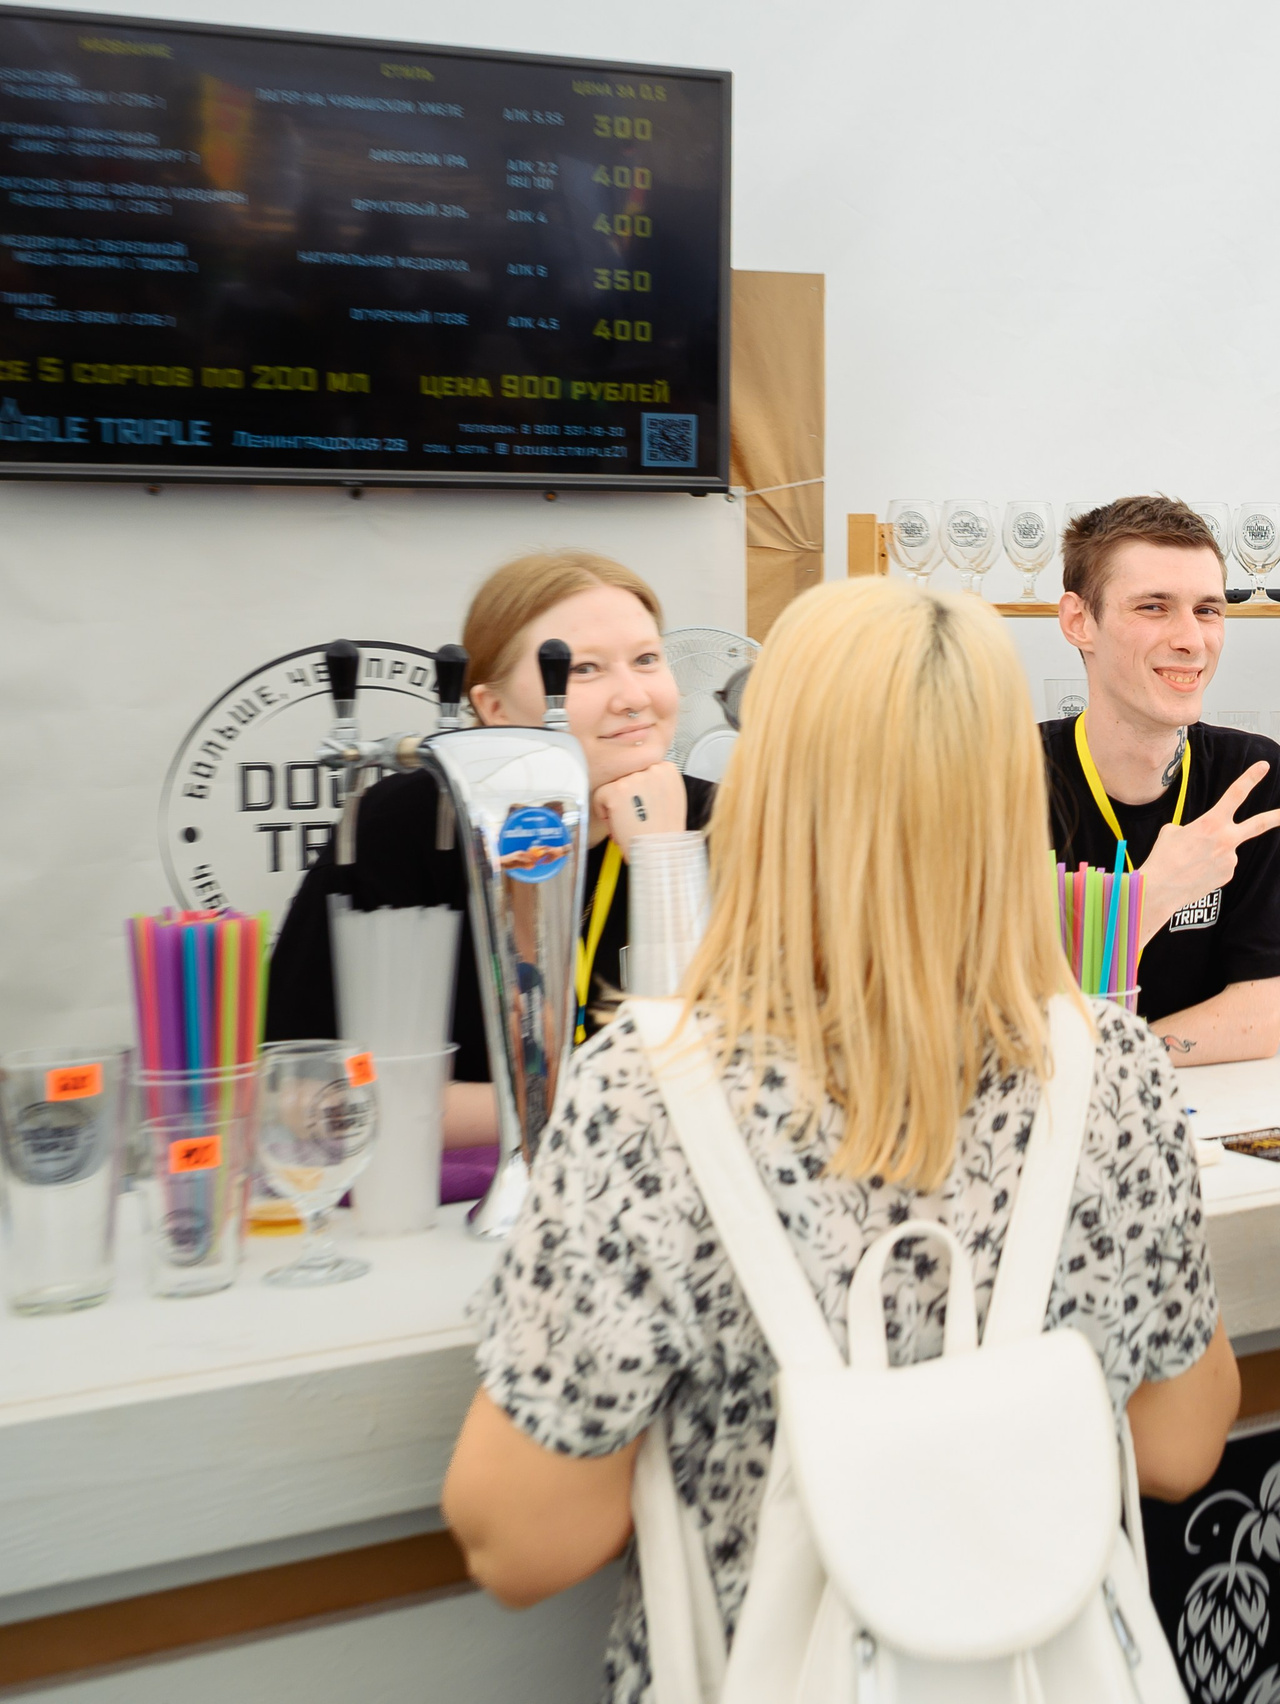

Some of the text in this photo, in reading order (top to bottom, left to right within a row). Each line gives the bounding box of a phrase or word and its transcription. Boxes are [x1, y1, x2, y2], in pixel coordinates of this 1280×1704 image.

[593, 114, 652, 141] 300
[592, 164, 652, 190] 400
[592, 212, 652, 238] 400
[593, 268, 652, 293] 350
[592, 319, 652, 343] 400
[38, 357, 65, 383] 5
[72, 362, 193, 388] СОРТОВ
[201, 366, 245, 389] ПО
[252, 365, 318, 392] 200
[420, 374, 670, 403] ЦЕНА 900 РУБЛЕЙ
[95, 416, 213, 447] TRIPLE
[1174, 906, 1218, 926] TRIPLE
